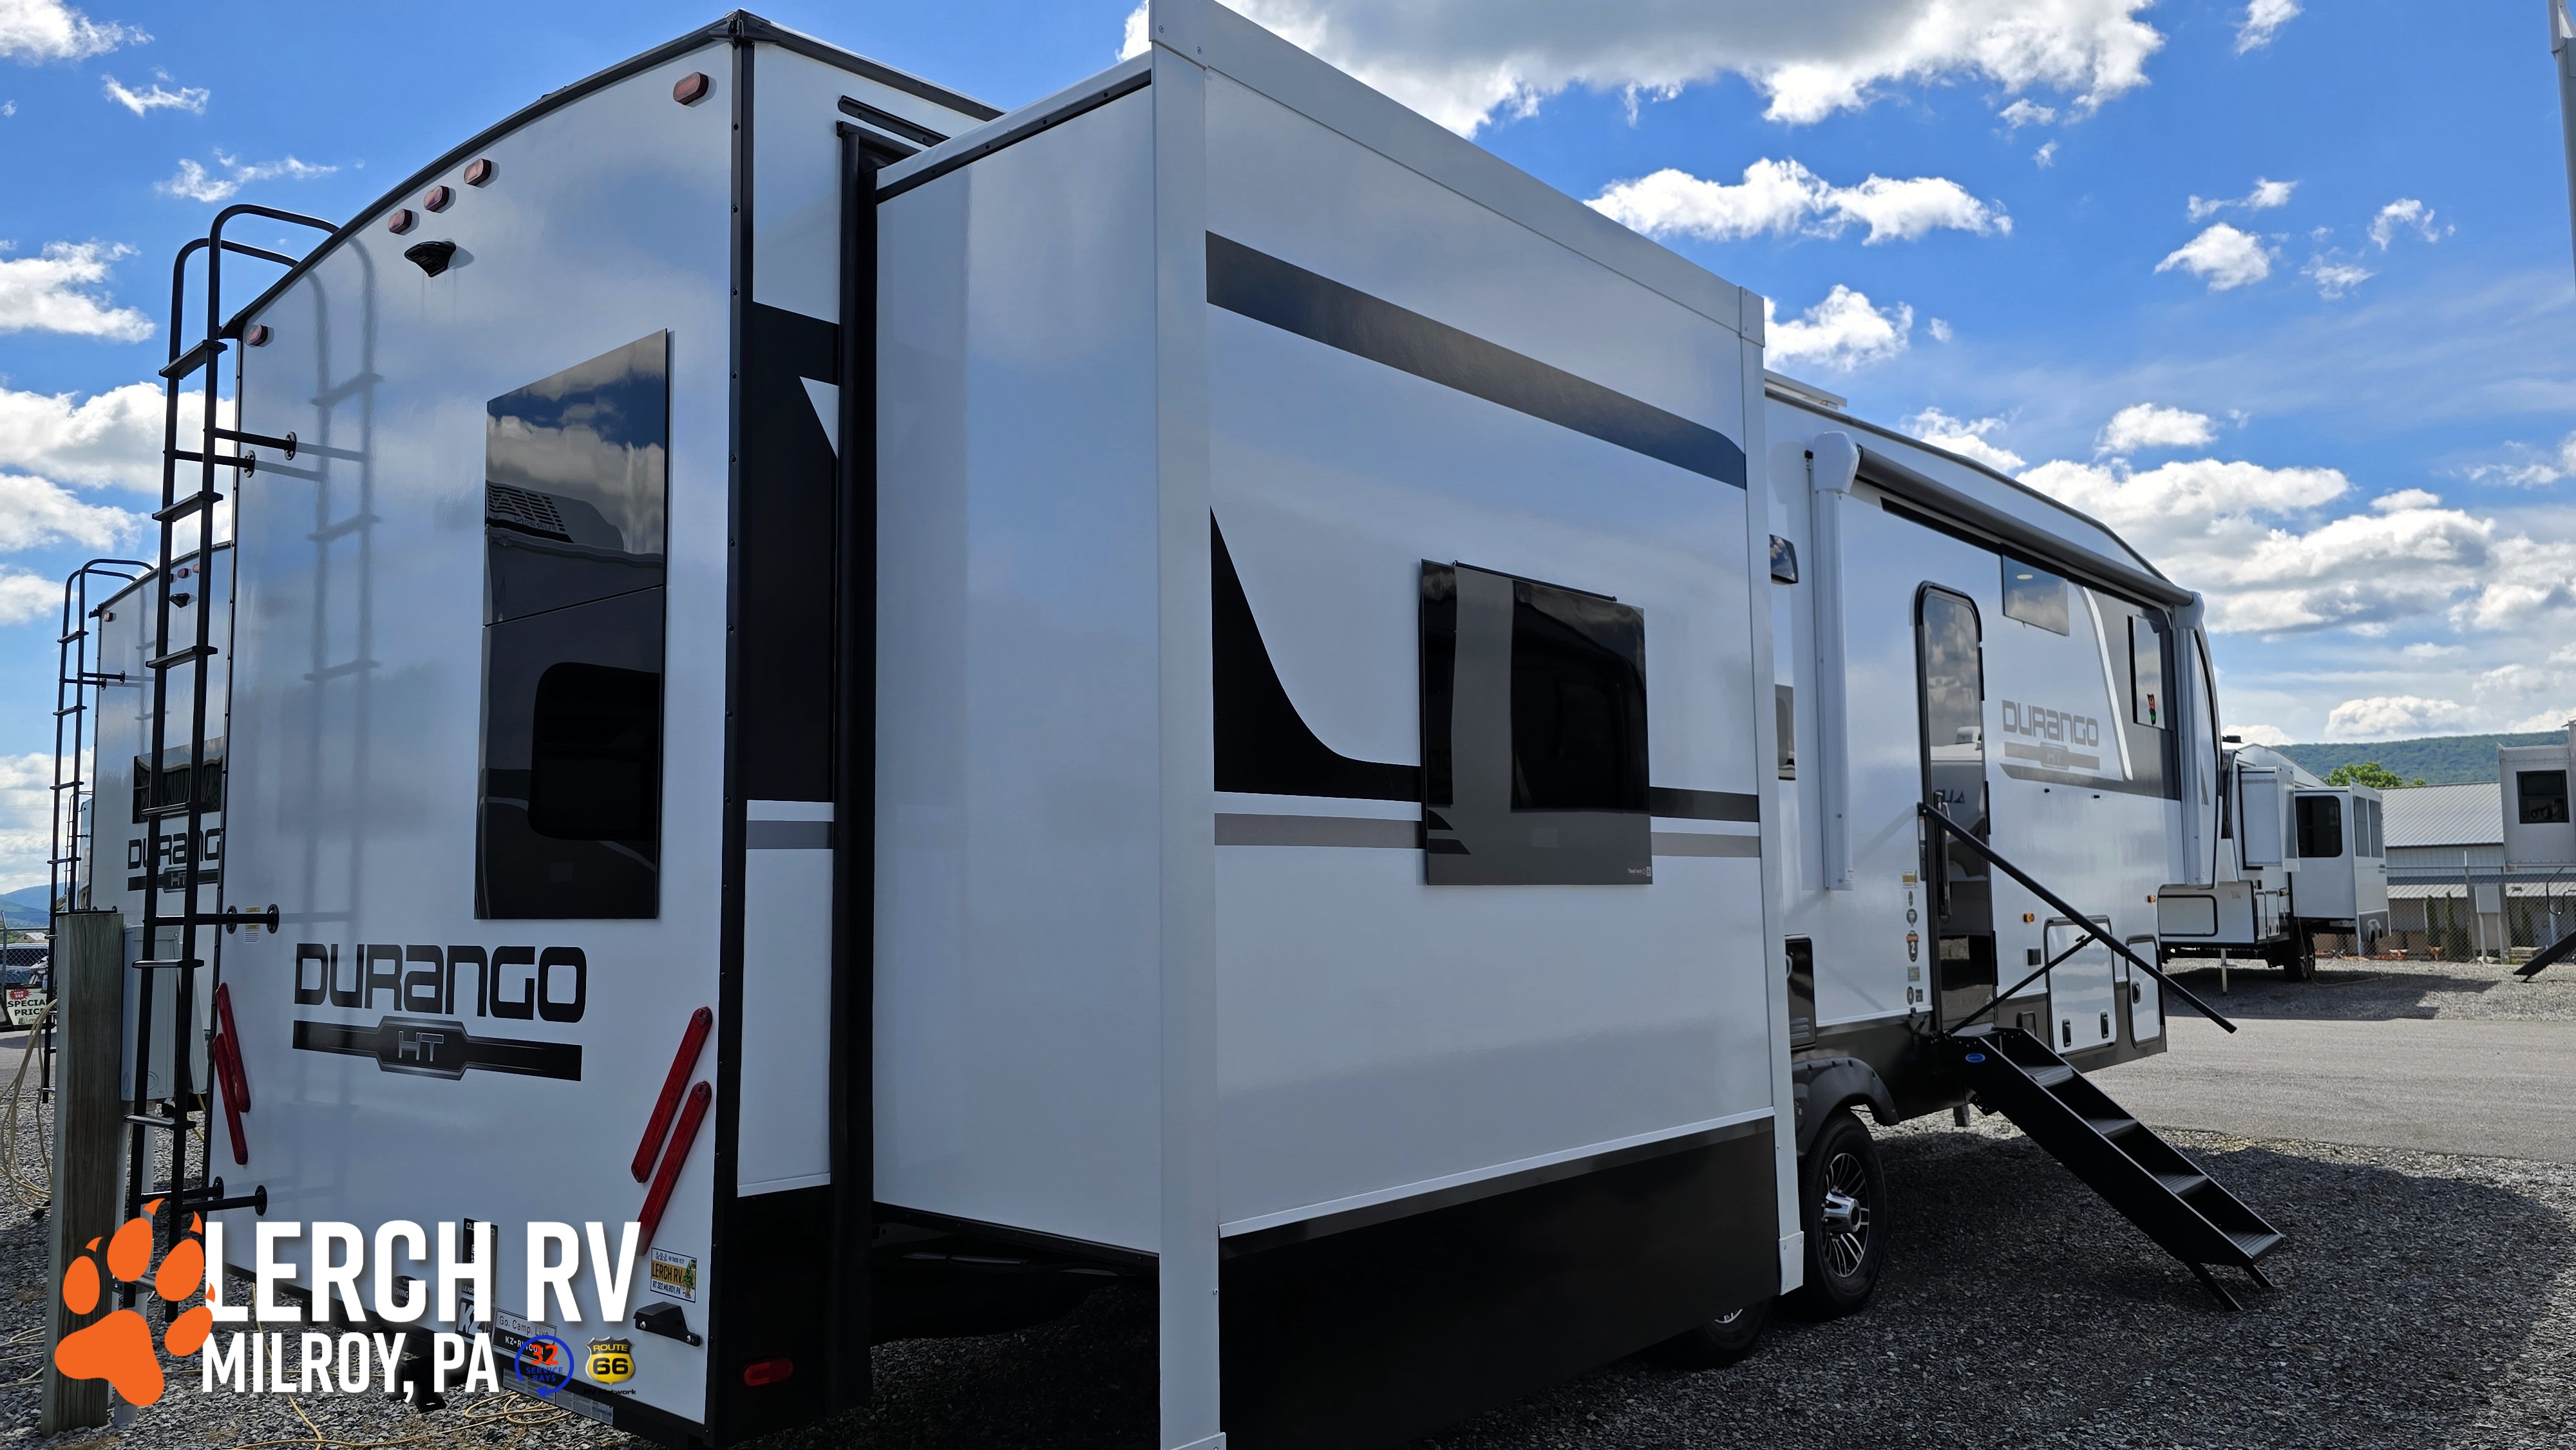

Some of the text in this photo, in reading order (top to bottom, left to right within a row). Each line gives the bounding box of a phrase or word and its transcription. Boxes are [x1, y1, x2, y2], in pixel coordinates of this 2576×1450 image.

[294, 943, 587, 1023] DURANGO
[398, 1031, 444, 1062] HT
[652, 1262, 683, 1284] LERCH RV
[499, 1315, 510, 1327] Go.
[513, 1319, 533, 1336] Camp.
